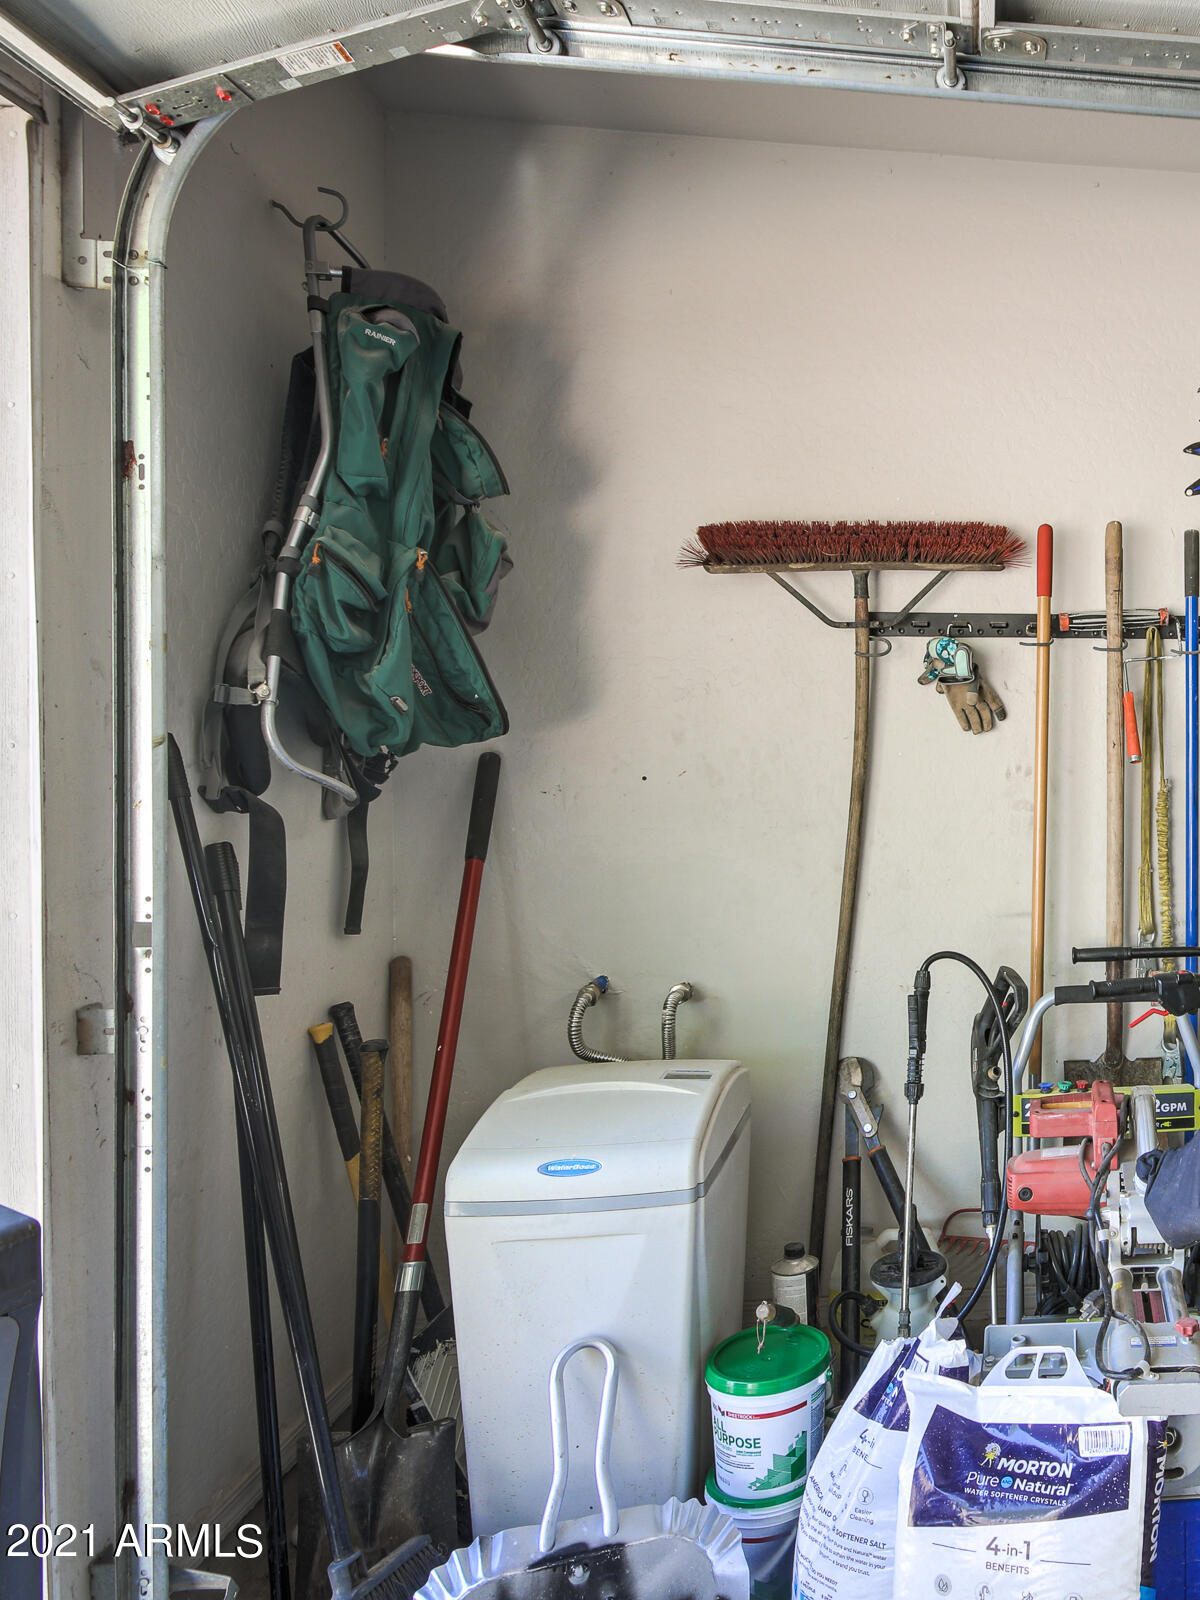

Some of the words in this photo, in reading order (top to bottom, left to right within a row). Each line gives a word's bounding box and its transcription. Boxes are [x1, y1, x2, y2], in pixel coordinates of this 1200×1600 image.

[364, 328, 396, 346] RAINIER
[845, 1187, 854, 1246] FISKARS
[713, 1415, 727, 1433] ALL
[714, 1429, 761, 1449] PURPOSE
[997, 1458, 1073, 1478] MORTON
[966, 1472, 999, 1487] Pure
[964, 1487, 988, 1497] WATER
[991, 1491, 1028, 1502] SOFTENER
[1030, 1496, 1067, 1507] CRYSTALS
[849, 1513, 874, 1525] Cleaning
[1149, 1457, 1167, 1563] MORTON
[835, 1529, 868, 1546] SOFTENER
[869, 1539, 886, 1550] SALT
[986, 1536, 1031, 1560] 4-in-1
[985, 1561, 1030, 1575] BENEFITS
